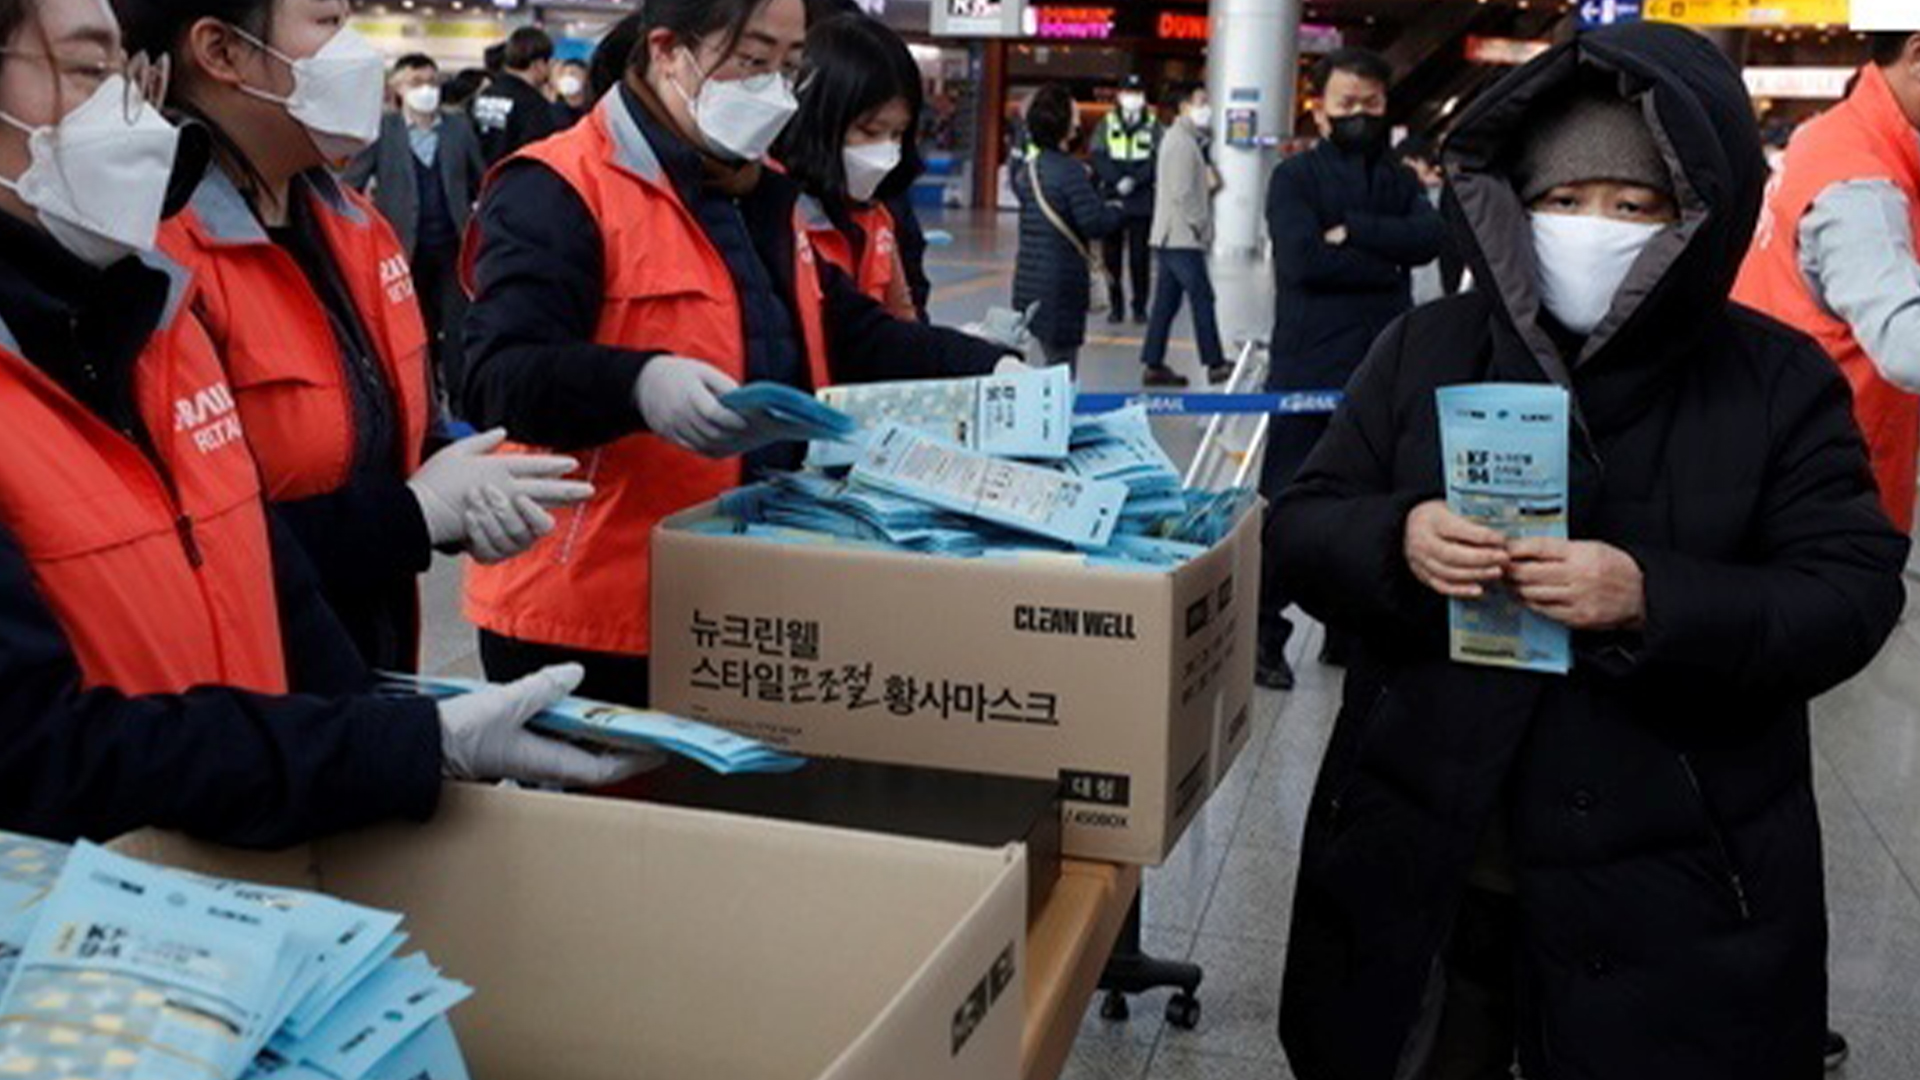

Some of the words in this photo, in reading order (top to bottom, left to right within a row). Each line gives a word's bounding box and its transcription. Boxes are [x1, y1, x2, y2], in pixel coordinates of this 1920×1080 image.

[690, 607, 820, 662] 뉴크린웰
[1014, 604, 1079, 635] CLEAN
[1083, 610, 1137, 640] WELL
